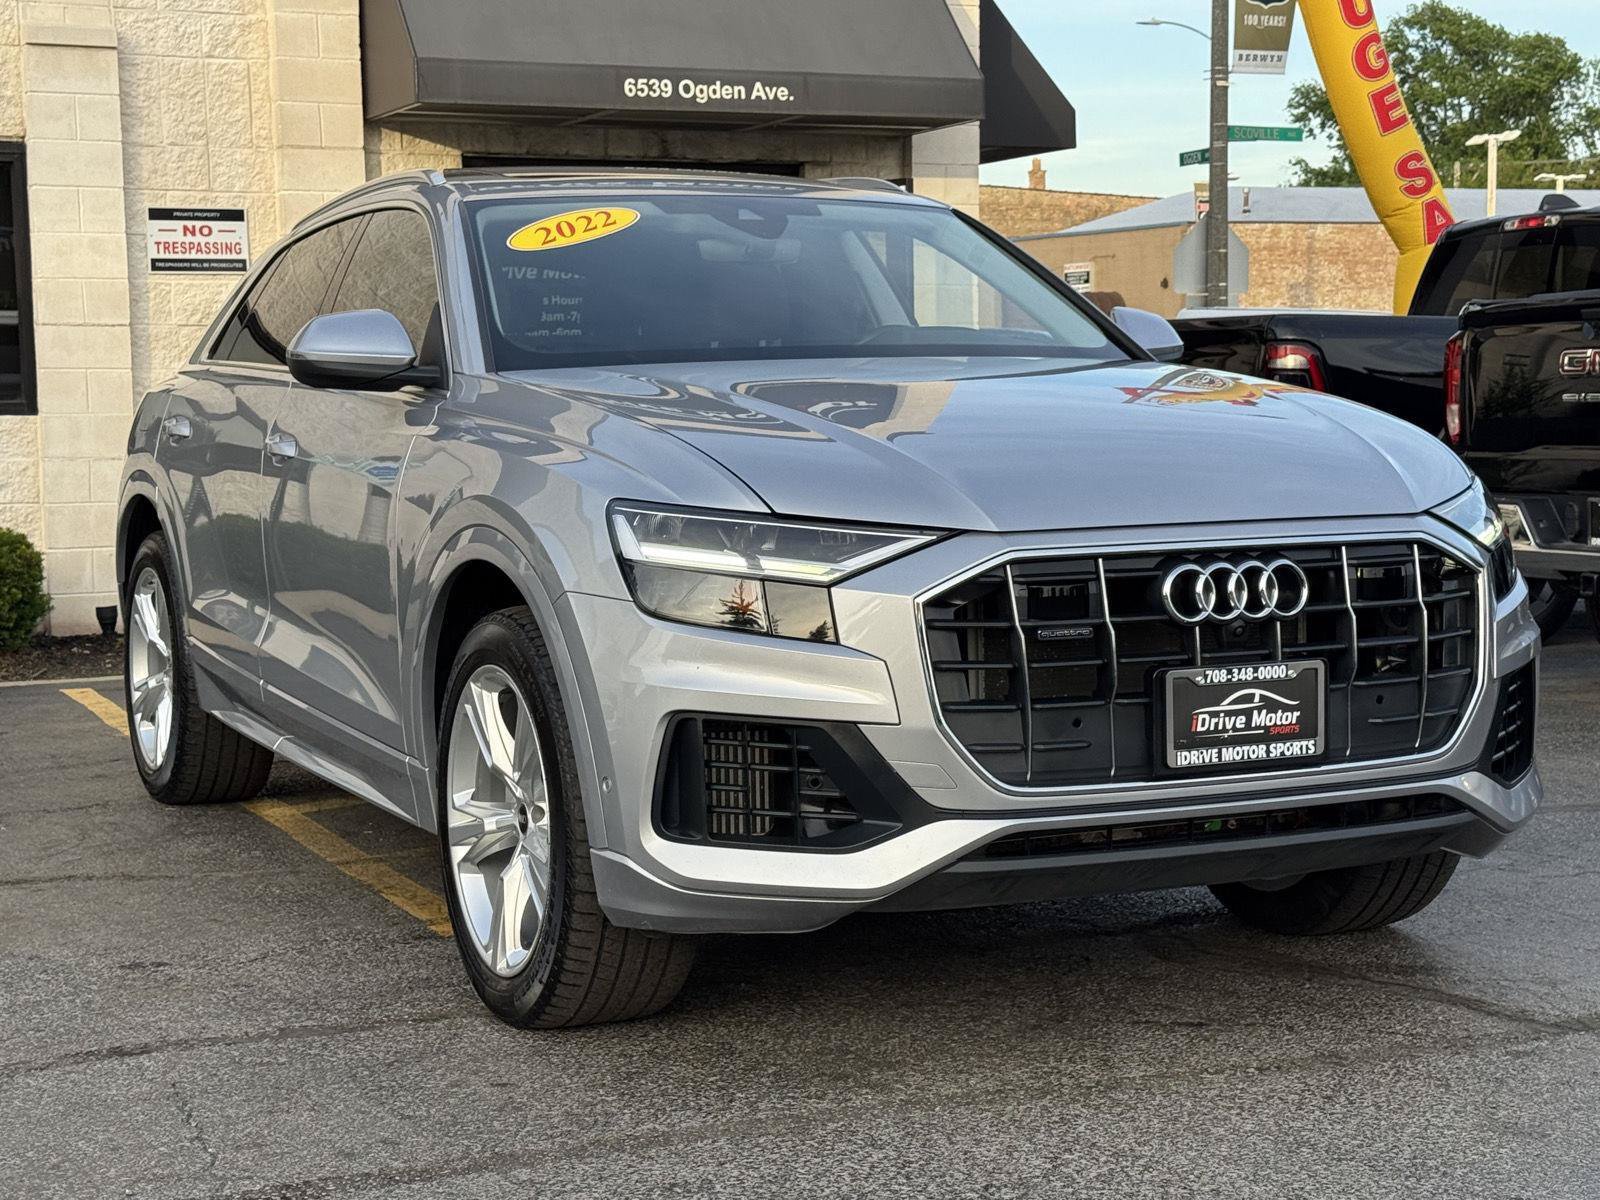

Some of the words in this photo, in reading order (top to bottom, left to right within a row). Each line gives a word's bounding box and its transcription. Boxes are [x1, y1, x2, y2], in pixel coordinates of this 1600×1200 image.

[1243, 14, 1259, 26] 100
[1237, 53, 1283, 63] BERWYN
[623, 78, 672, 98] 6539
[678, 79, 746, 103] Ogden
[750, 81, 795, 101] Ave.
[1234, 128, 1280, 140] SCOVILLE
[1183, 151, 1202, 164] OGDEN
[182, 224, 213, 237] NO
[534, 210, 617, 247] 2022
[154, 241, 242, 255] TRESPASSING
[1041, 629, 1090, 638] quattro
[1205, 665, 1287, 684] 708-348-0000
[1191, 712, 1246, 732] iDrive
[1252, 709, 1300, 728] Motor
[1269, 724, 1300, 735] SPORTS
[1221, 746, 1268, 762] MOTOR
[1269, 740, 1316, 757] SPORTS
